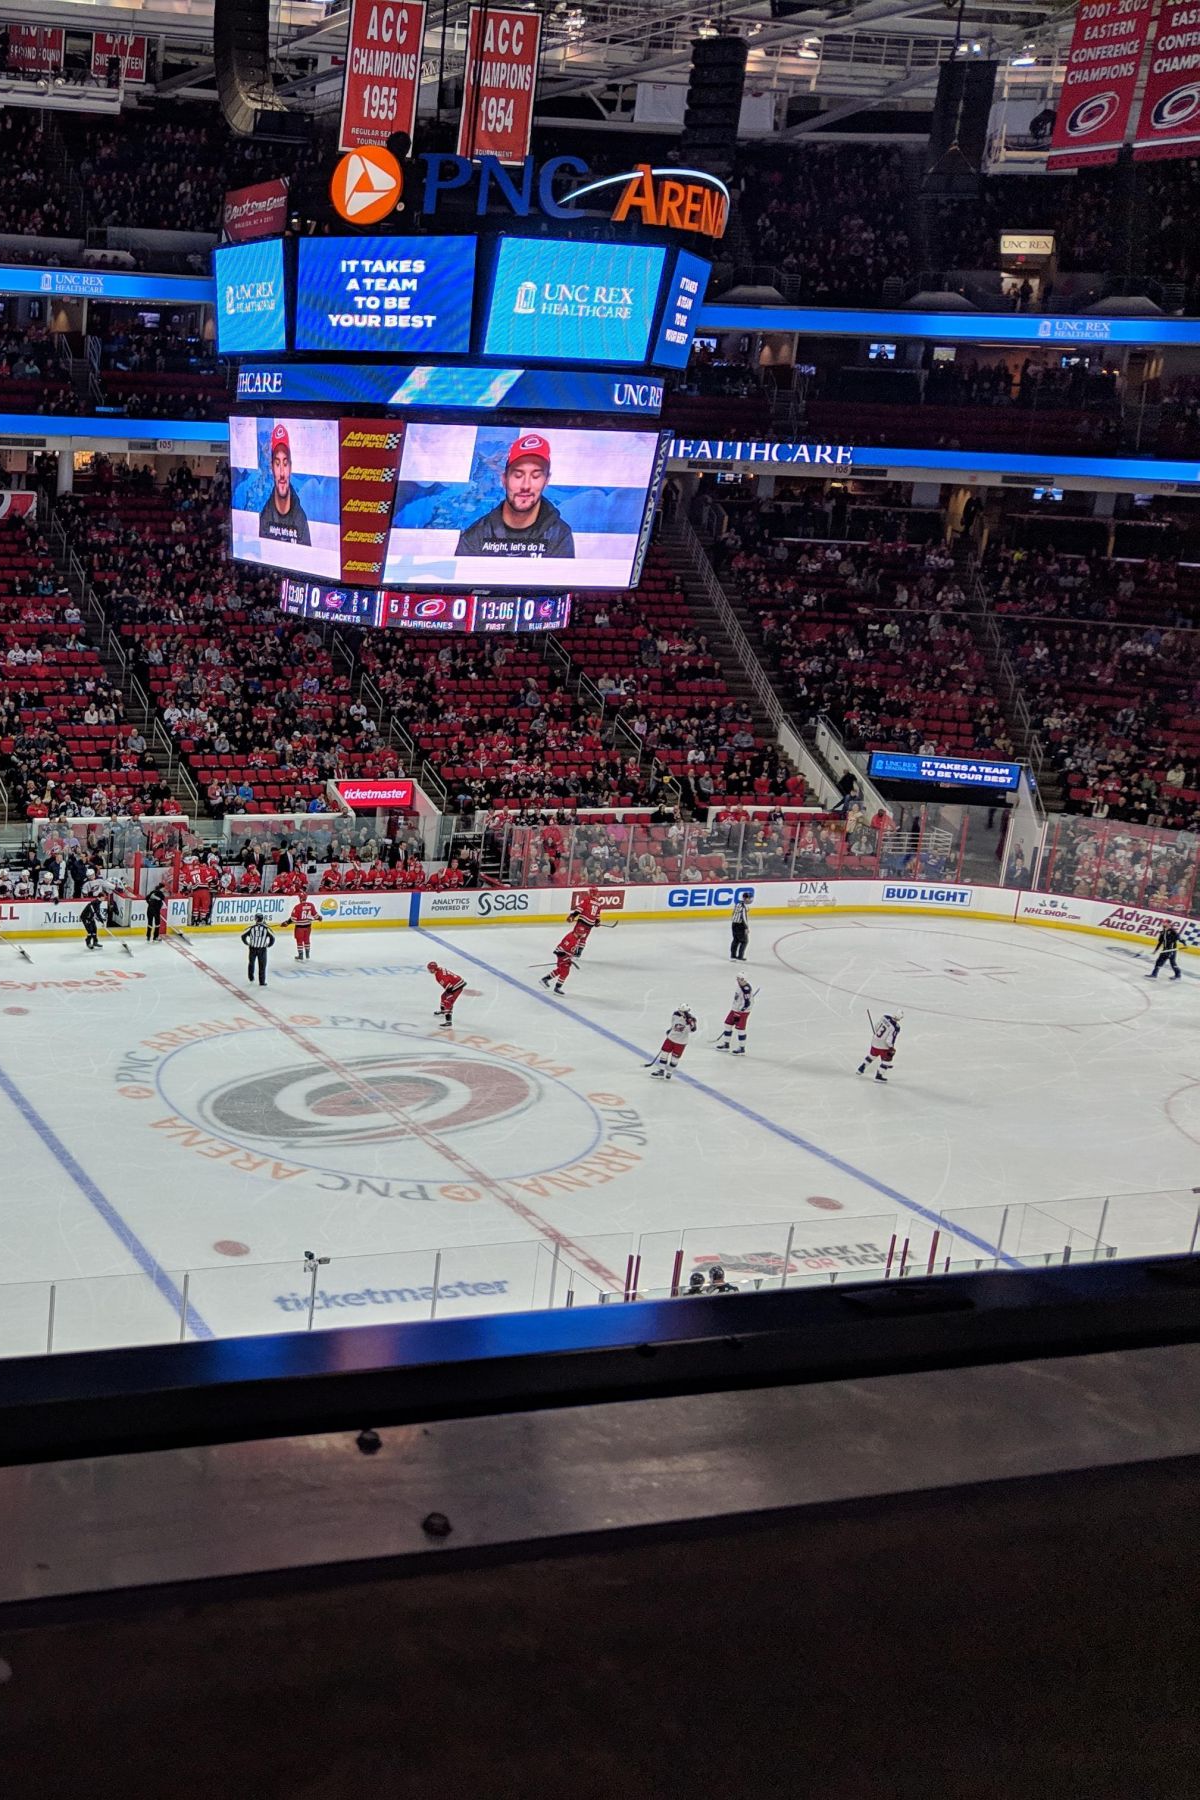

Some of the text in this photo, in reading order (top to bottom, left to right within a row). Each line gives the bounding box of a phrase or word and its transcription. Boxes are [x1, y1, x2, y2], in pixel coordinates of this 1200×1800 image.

[366, 6, 409, 45] ACC
[1084, 19, 1138, 40] EASTERN
[483, 18, 524, 56] ACC
[1072, 40, 1140, 63] CONFERENCE
[352, 48, 416, 81] CHAMPIONS
[1067, 62, 1137, 85] CHAMPIONS
[363, 84, 398, 120] 1955
[481, 96, 514, 133] 1954
[351, 127, 379, 137] REGULAR
[419, 152, 727, 239] PNC ARENA
[1003, 240, 1051, 249] UNC REX
[341, 260, 426, 273] IT TAKES
[55, 271, 104, 286] UNC REX
[346, 279, 418, 292] A TEAM
[55, 281, 104, 293] HEALTHCARE
[544, 283, 635, 305] UNC REX
[355, 297, 411, 310] TO BE
[541, 302, 632, 320] HEALTHCARE
[328, 314, 437, 328] YOUR BEST
[1055, 321, 1111, 333] UNC REX
[1054, 330, 1110, 341] HEALTHCARE
[614, 384, 648, 406] UNC
[346, 431, 386, 442] Advance
[160, 440, 173, 449] 105
[341, 439, 385, 449] Auto Parts
[346, 466, 382, 475] Advance
[341, 474, 382, 482] Auto Parts
[346, 499, 379, 508] Advance
[346, 530, 376, 539] Advance
[482, 542, 509, 553] Alright,
[510, 542, 526, 552] let's
[527, 543, 538, 552] do
[310, 588, 321, 608] 0
[363, 597, 370, 611] 1
[390, 599, 399, 614] 5
[452, 599, 467, 620] 0
[481, 601, 515, 619] 13:06
[523, 600, 536, 621] 0
[315, 610, 506, 631] BLUE JACKETS HURRICANES FIRST
[934, 761, 1010, 775] TAKES TEAM
[953, 772, 983, 781] YOUR
[983, 774, 1014, 784] BEST
[344, 788, 408, 801] ticketmaster
[798, 881, 830, 896] DNA
[432, 897, 470, 905] ANALYTICS
[493, 893, 529, 911] sas
[668, 887, 755, 908] GEICO
[886, 888, 968, 904] BUD LIGHT
[217, 899, 285, 914] ORTHOPAEDIC
[340, 905, 382, 918] Lottery
[216, 915, 237, 923] TEAM
[1098, 918, 1136, 932] Auto
[790, 1242, 881, 1259] CLICK IT
[274, 1279, 510, 1313] ticketmaster
